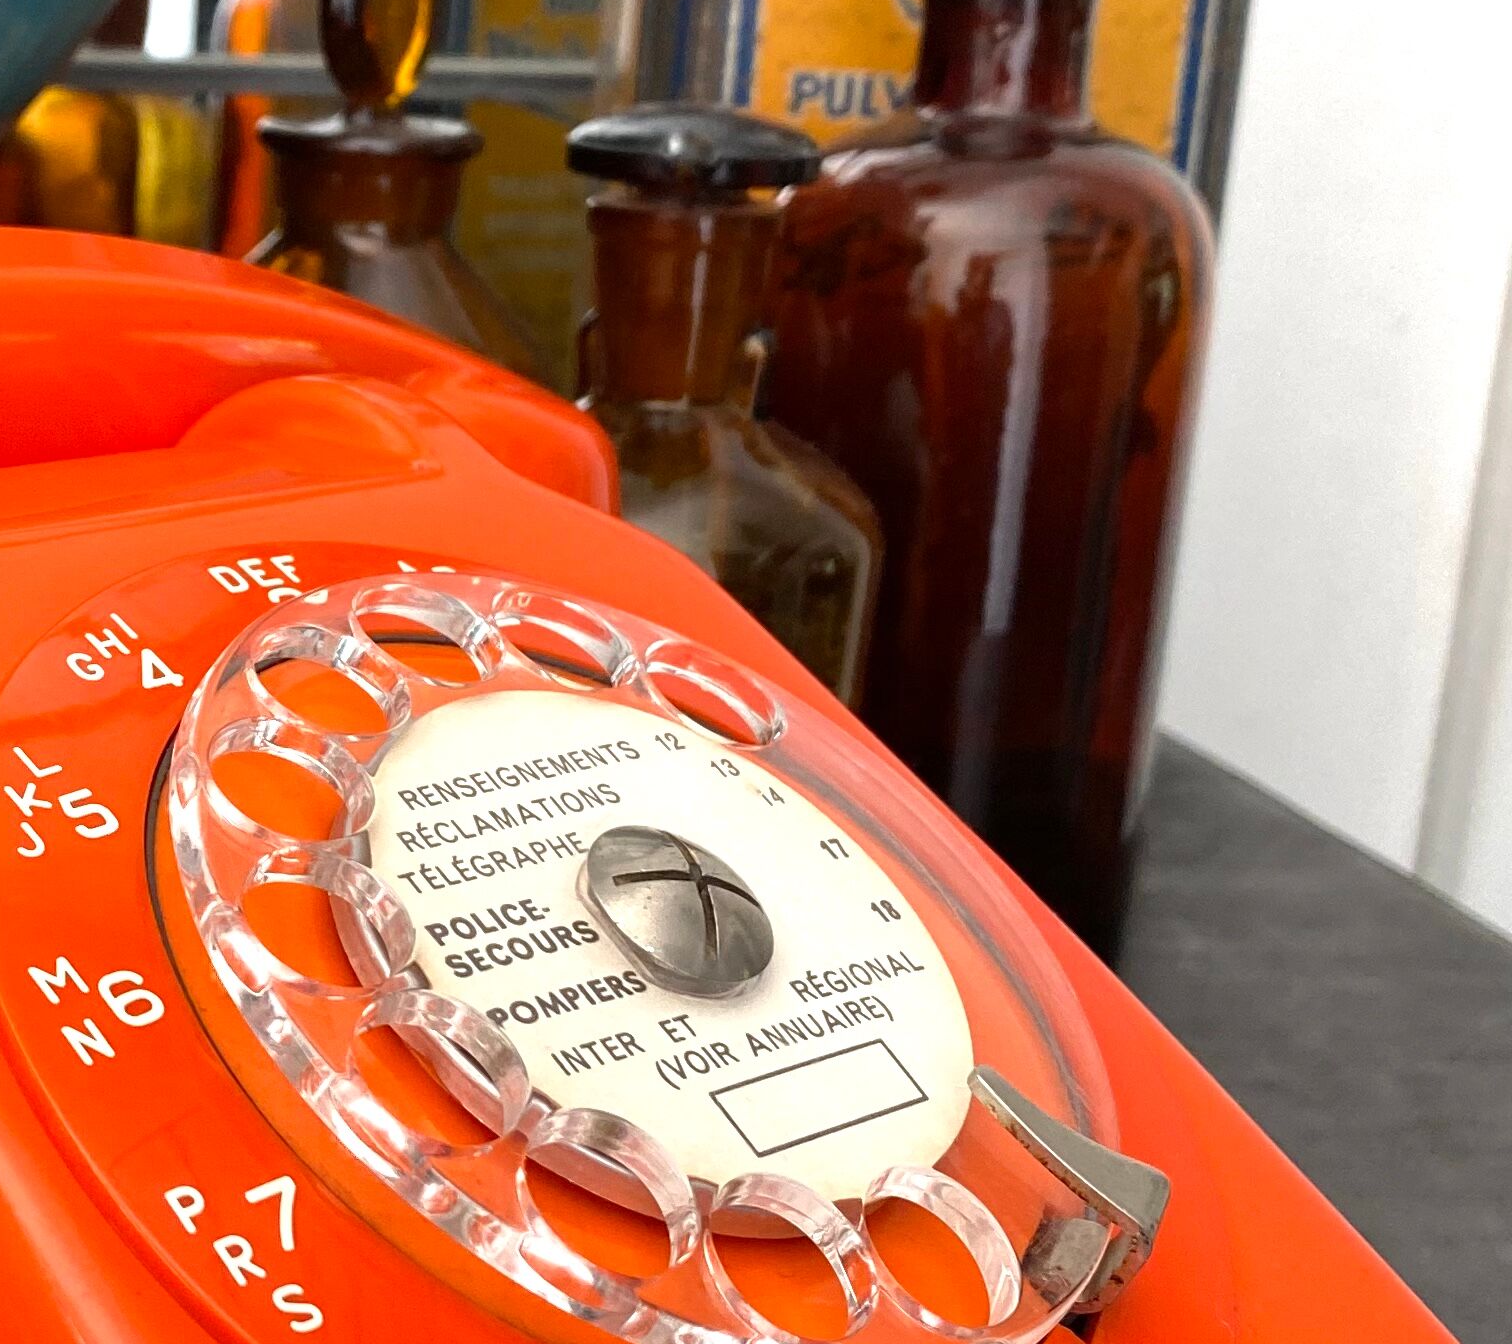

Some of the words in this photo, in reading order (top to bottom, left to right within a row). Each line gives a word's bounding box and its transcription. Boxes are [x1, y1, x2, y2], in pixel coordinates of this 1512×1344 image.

[788, 71, 918, 119] PULV
[208, 555, 300, 594] DEF
[66, 612, 138, 681] GHI
[142, 648, 184, 689] 4
[396, 782, 622, 854] RÉCLAMATIONS
[710, 757, 741, 780] 13
[398, 739, 641, 812] RENSEIGNEMENTS
[654, 732, 687, 754] 12
[58, 787, 120, 839] 5
[397, 830, 590, 896] TÉLÉGRAPHE
[761, 786, 786, 807] 14
[425, 897, 551, 948] POLICE-
[819, 837, 849, 862] 17
[444, 919, 601, 980] SECOURS
[488, 969, 648, 1030] POMPIERS
[870, 899, 902, 925] 18
[97, 970, 165, 1027] 6
[550, 1031, 647, 1078] INTER
[658, 1014, 698, 1043] ET
[788, 950, 926, 1002] RÉGIONAL
[654, 1043, 741, 1091] (VOIR
[745, 994, 896, 1057] ANNUAIRE)
[245, 1174, 296, 1253] 7
